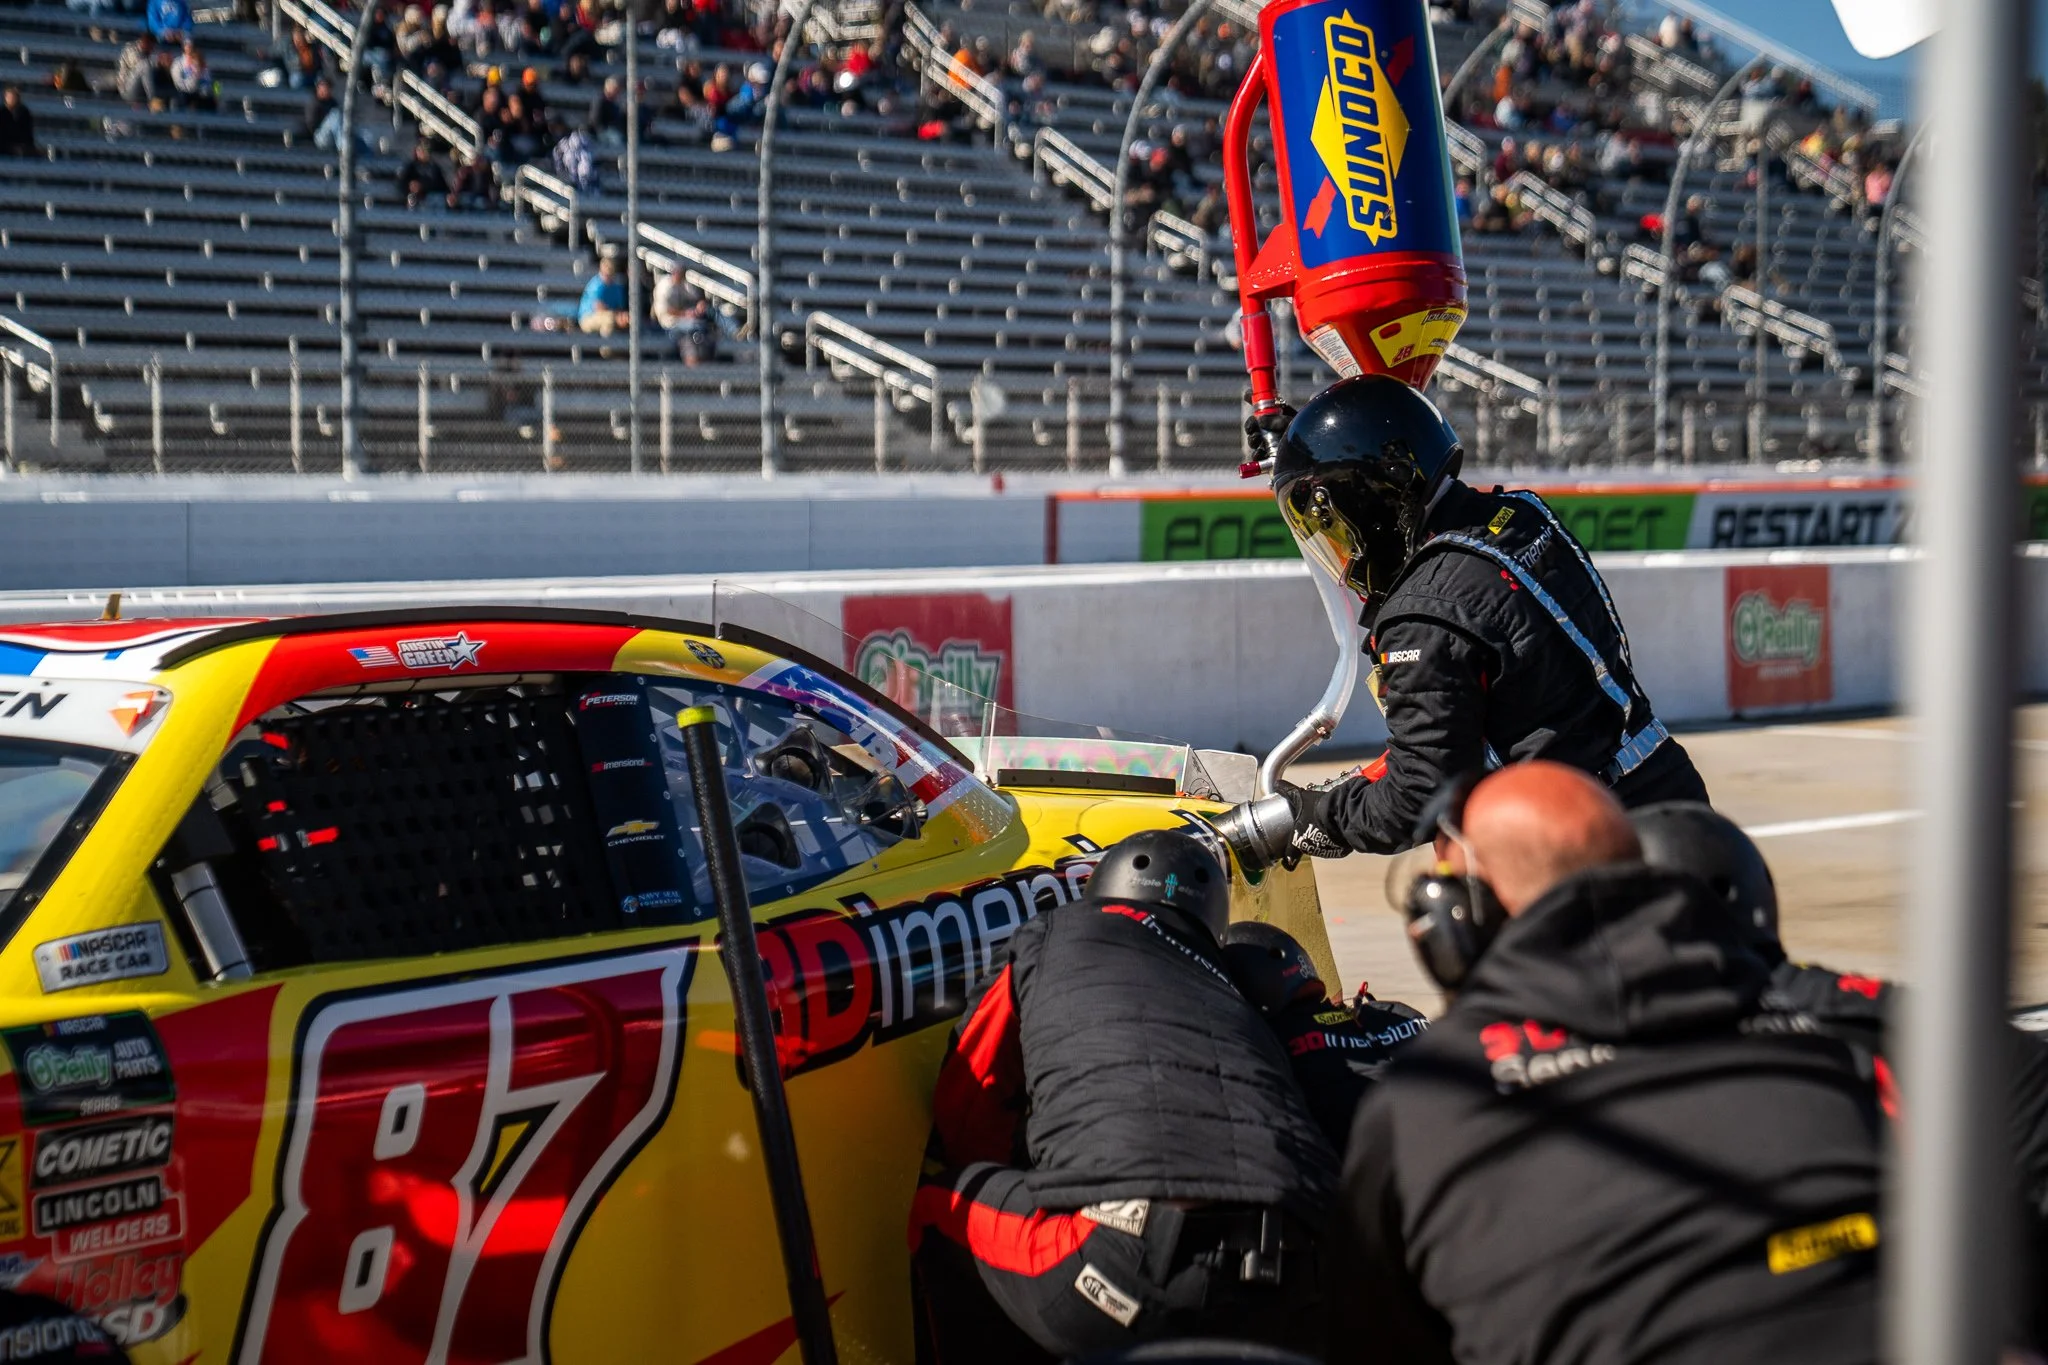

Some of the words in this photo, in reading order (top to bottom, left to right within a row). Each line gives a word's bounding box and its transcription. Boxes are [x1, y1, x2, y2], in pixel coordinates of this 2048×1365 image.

[1330, 23, 1393, 232] SUNOCO
[1490, 507, 1514, 531] Sabelt
[1557, 504, 1665, 551] OET
[1710, 502, 1888, 549] RESTART
[1164, 512, 1289, 560] POE
[400, 640, 446, 653] AUSTIN
[402, 648, 458, 667] GREEN
[1388, 649, 1421, 664] NASCAR
[585, 693, 638, 706] PETERSON
[607, 834, 665, 847] CHEVROLET
[1291, 829, 1344, 858] Mechanix
[638, 891, 660, 900] NAVY
[662, 890, 680, 898] SEAL
[79, 931, 147, 957] NASCAR
[59, 958, 110, 981] RACE
[114, 952, 151, 971] CAR
[58, 1015, 108, 1036] NASCAR
[1318, 1012, 1351, 1026] Sabe
[26, 1044, 112, 1091] O'Reilly
[113, 1037, 152, 1059] AUTO
[114, 1055, 162, 1080] PARTS
[79, 1095, 122, 1117] SERIES
[36, 1119, 171, 1177] COMETIC
[237, 946, 690, 1365] 87
[40, 1182, 157, 1228] LINCOLN
[70, 1213, 171, 1255] WELDERS
[55, 1253, 184, 1314] Holley
[88, 1304, 166, 1346] SD
